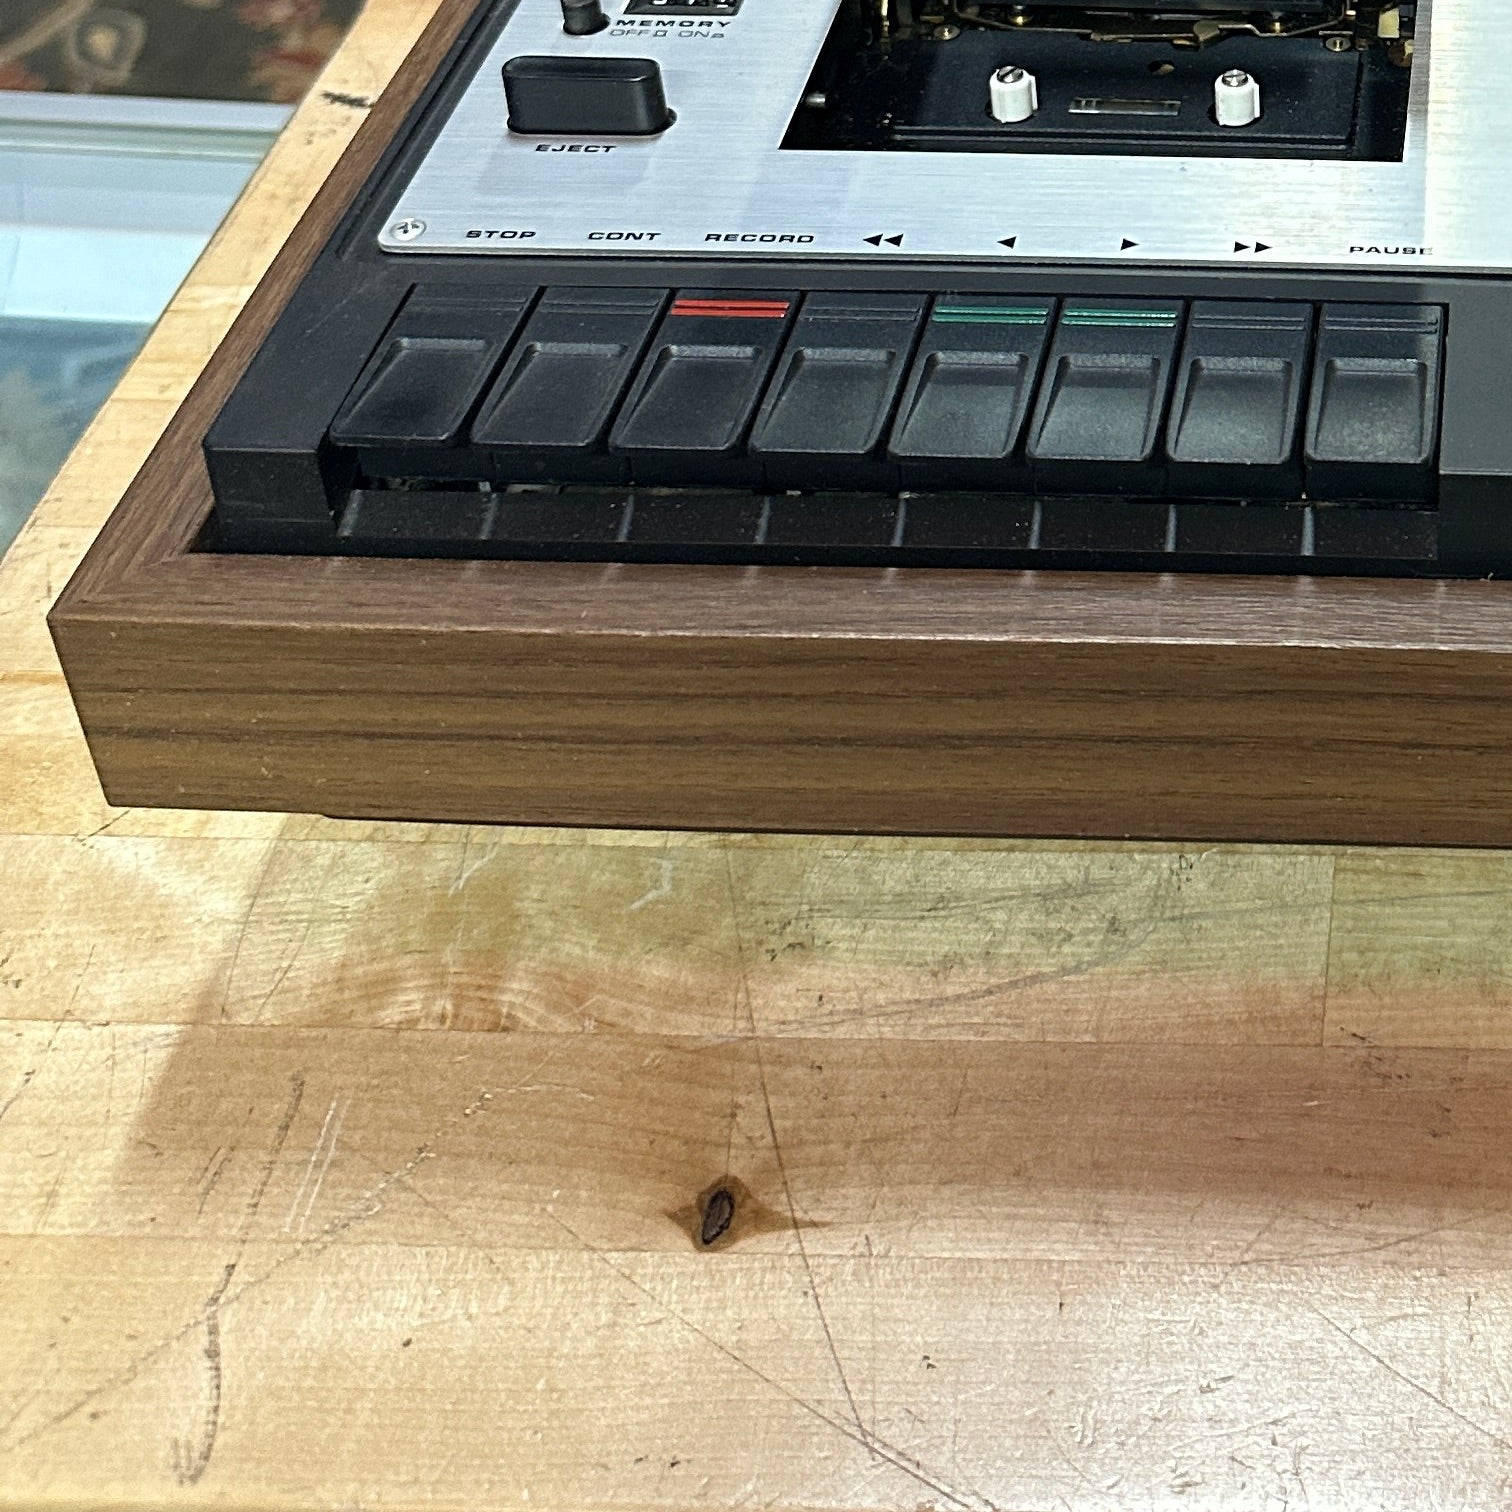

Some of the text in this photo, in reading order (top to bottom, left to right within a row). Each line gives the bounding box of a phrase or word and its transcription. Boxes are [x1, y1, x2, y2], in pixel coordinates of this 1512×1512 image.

[615, 19, 732, 28] MEMORY
[535, 144, 617, 153] EJECT
[466, 230, 537, 239] STOP
[588, 232, 661, 241] CONT
[704, 233, 816, 244] RECORD
[1350, 245, 1433, 256] PAUSE
